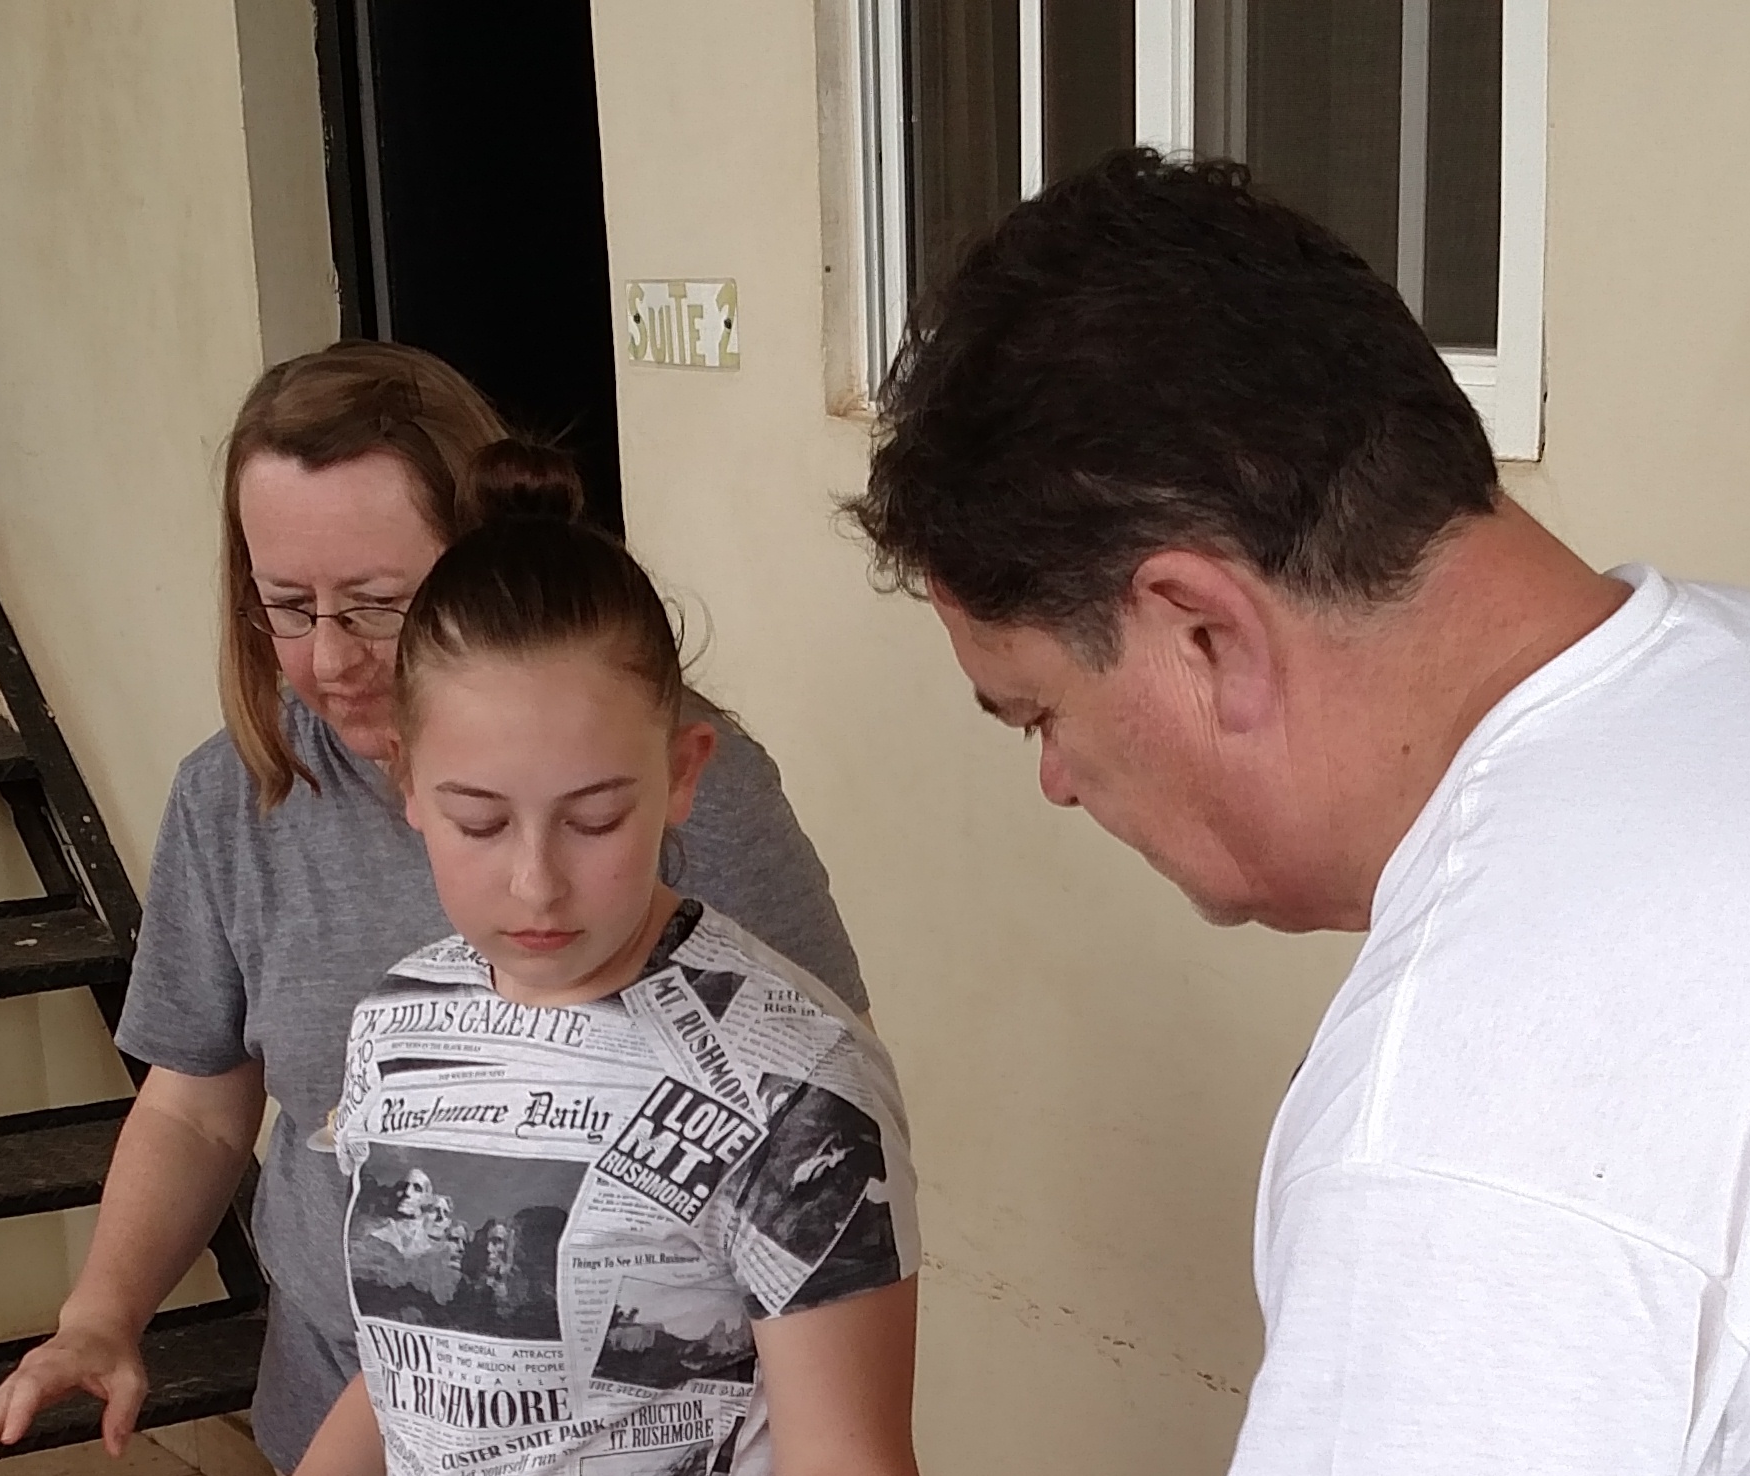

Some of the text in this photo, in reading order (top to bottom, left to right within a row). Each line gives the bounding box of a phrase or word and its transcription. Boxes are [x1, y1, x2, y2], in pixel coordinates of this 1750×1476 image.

[627, 281, 740, 368] SUITE 2
[381, 1001, 457, 1035] HILLS
[458, 1000, 591, 1048] GAZETTE
[649, 977, 689, 1014] MT.
[672, 1010, 758, 1118] RUSHMOR
[380, 1091, 612, 1143] Rushmore Daily
[644, 1081, 755, 1164] I LOVE
[618, 1117, 713, 1199] MT.
[600, 1151, 702, 1220] RUSHMORE
[572, 1257, 601, 1269] Things
[604, 1257, 614, 1268] To
[616, 1257, 631, 1267] See
[367, 1324, 434, 1373] ENJOY
[456, 1357, 472, 1368] TWO
[477, 1361, 515, 1373] MILLION
[525, 1363, 565, 1372] PEOPLE
[458, 1342, 496, 1357] MEMORIAL
[512, 1349, 564, 1359] ATTRACTS
[412, 1374, 573, 1429] RUSHMORE
[442, 1445, 501, 1470] CUSTER
[506, 1430, 553, 1453] STATE
[559, 1418, 607, 1442] PARK
[632, 1418, 714, 1448] RUSHMORE
[532, 1454, 557, 1468] run
